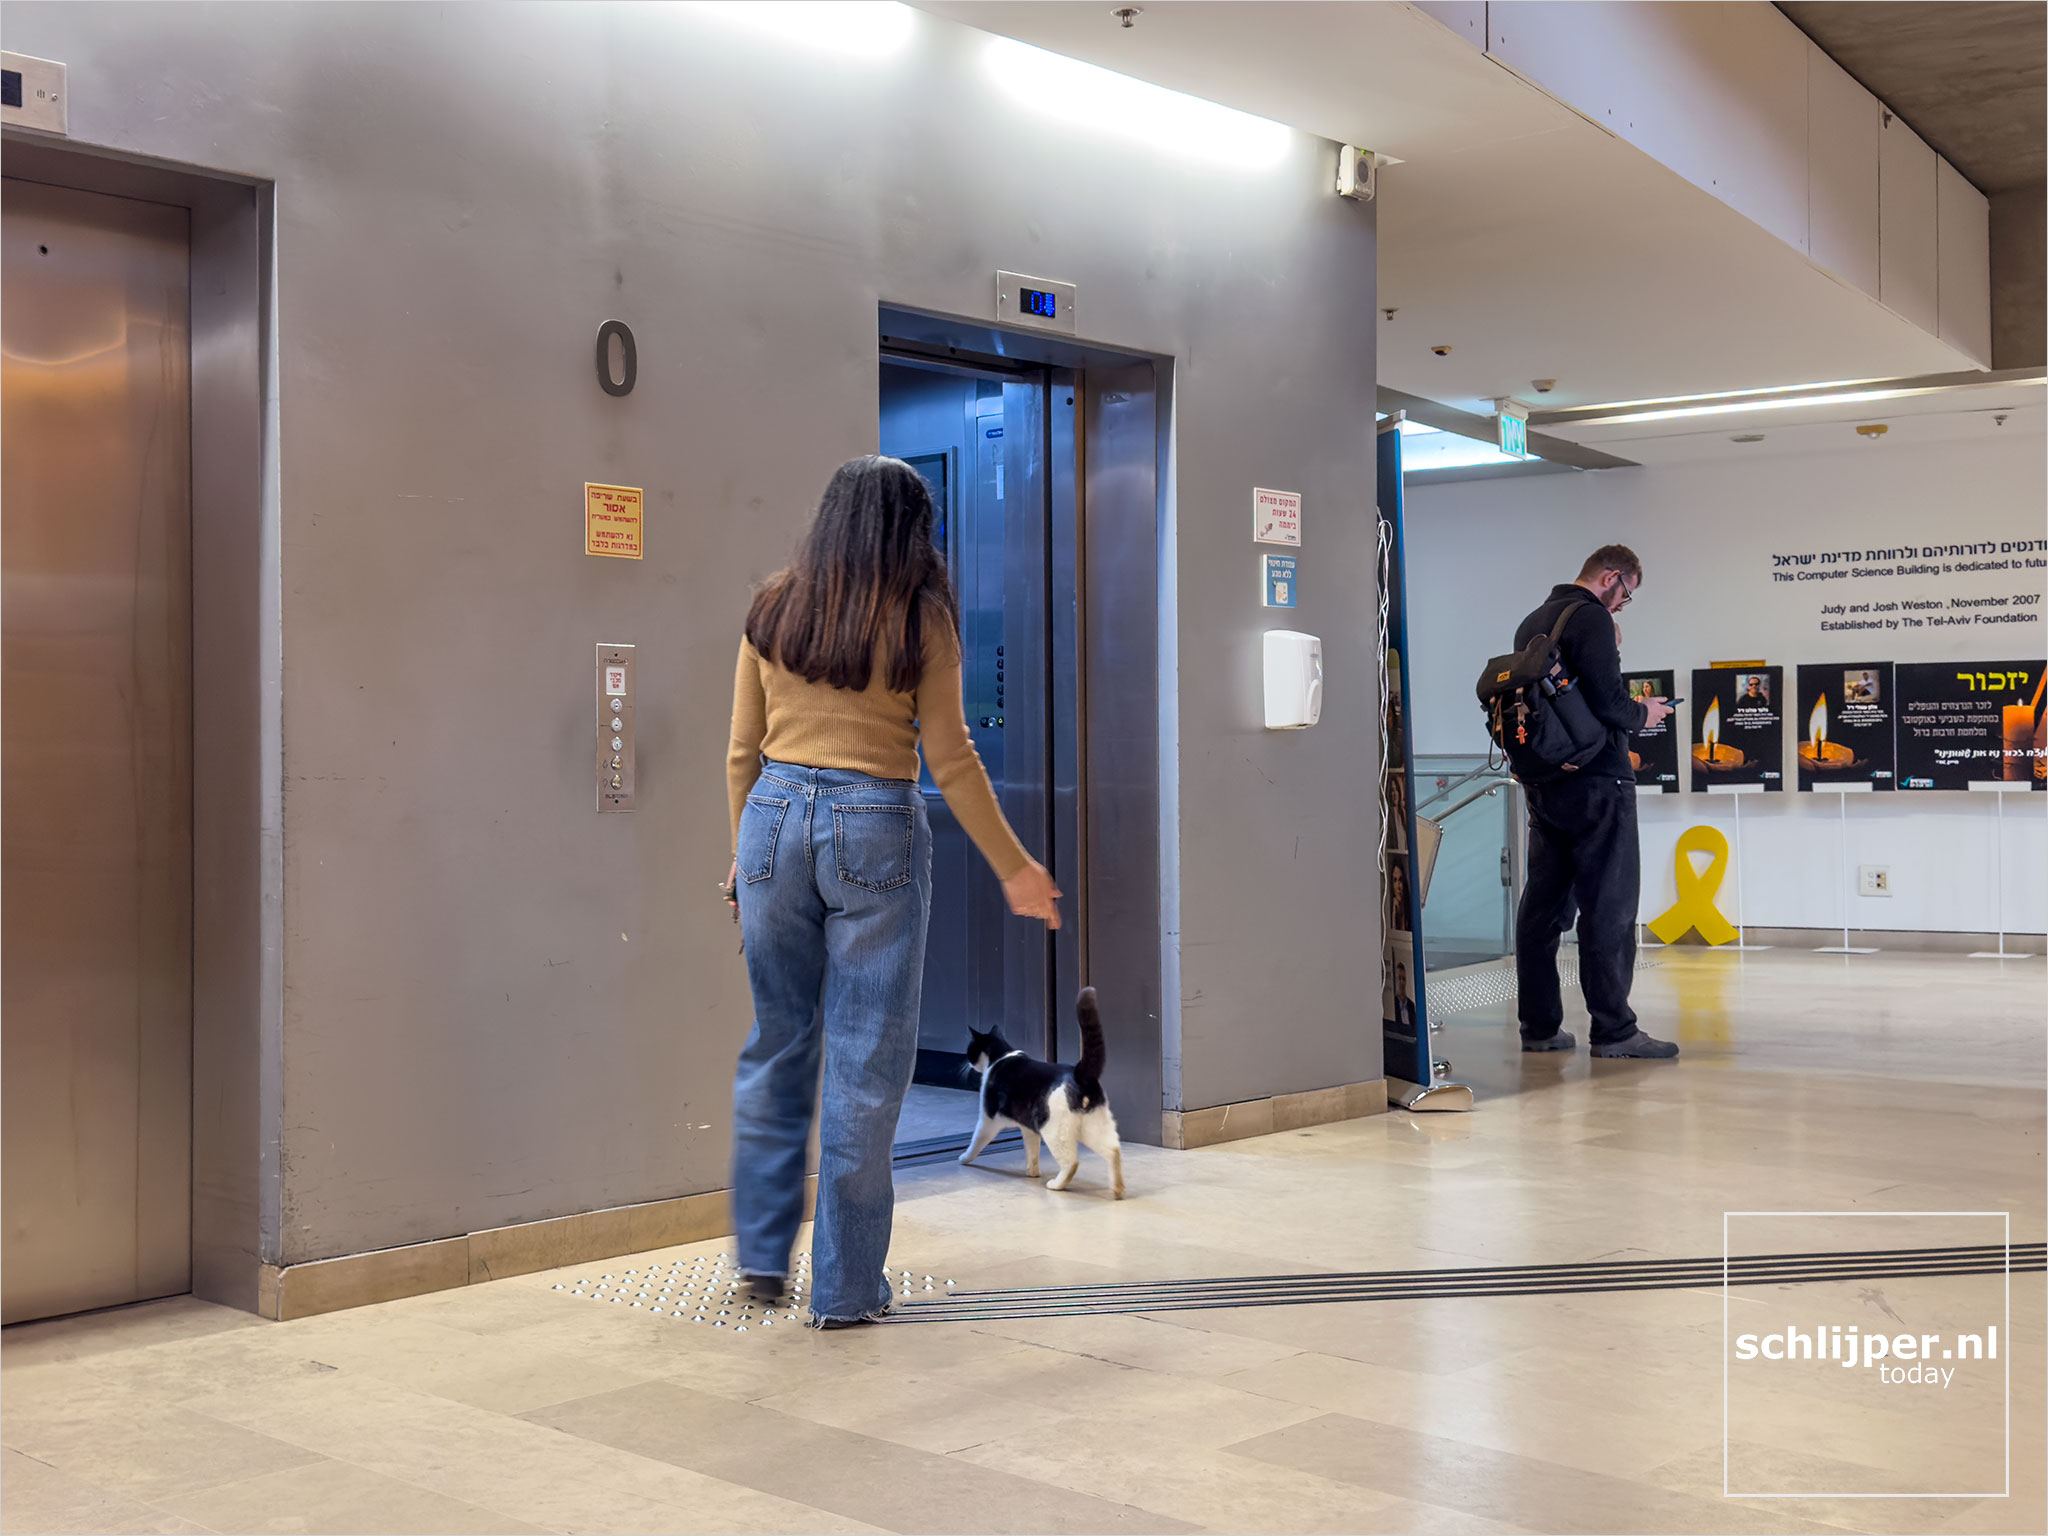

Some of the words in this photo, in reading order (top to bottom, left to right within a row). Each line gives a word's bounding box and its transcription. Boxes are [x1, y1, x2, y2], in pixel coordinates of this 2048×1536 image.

[595, 319, 637, 397] 0
[1260, 495, 1277, 505] מצולם
[1279, 498, 1297, 508] המקום
[603, 503, 626, 514] אסור
[1272, 508, 1287, 517] שעות
[1289, 510, 1297, 518] 24
[592, 540, 609, 548] בלבד
[626, 533, 633, 541] נא
[1865, 546, 1918, 562] ולרווחת
[1922, 541, 1996, 558] לדורותיהם
[1772, 553, 1817, 567] ישראל
[1820, 551, 1861, 565] מדינת
[1773, 571, 1795, 582] This
[1797, 569, 1848, 582] Computer
[1851, 567, 1894, 578] Science
[1897, 564, 1940, 577] Building
[1942, 562, 1952, 573] is
[1954, 559, 2008, 572] dedicated
[2012, 559, 2022, 569] to
[1821, 603, 1846, 615] Judy
[1849, 603, 1870, 613] and
[1873, 601, 1898, 612] Josh
[1901, 600, 1943, 611] Weston
[2012, 594, 2041, 605] 2007
[1821, 619, 1883, 631] Established
[1885, 618, 1899, 630] by
[1902, 617, 1923, 628] The
[1927, 614, 1971, 626] Tel-Aviv
[1974, 612, 2038, 625] Foundation
[1957, 671, 2029, 691] יזכור
